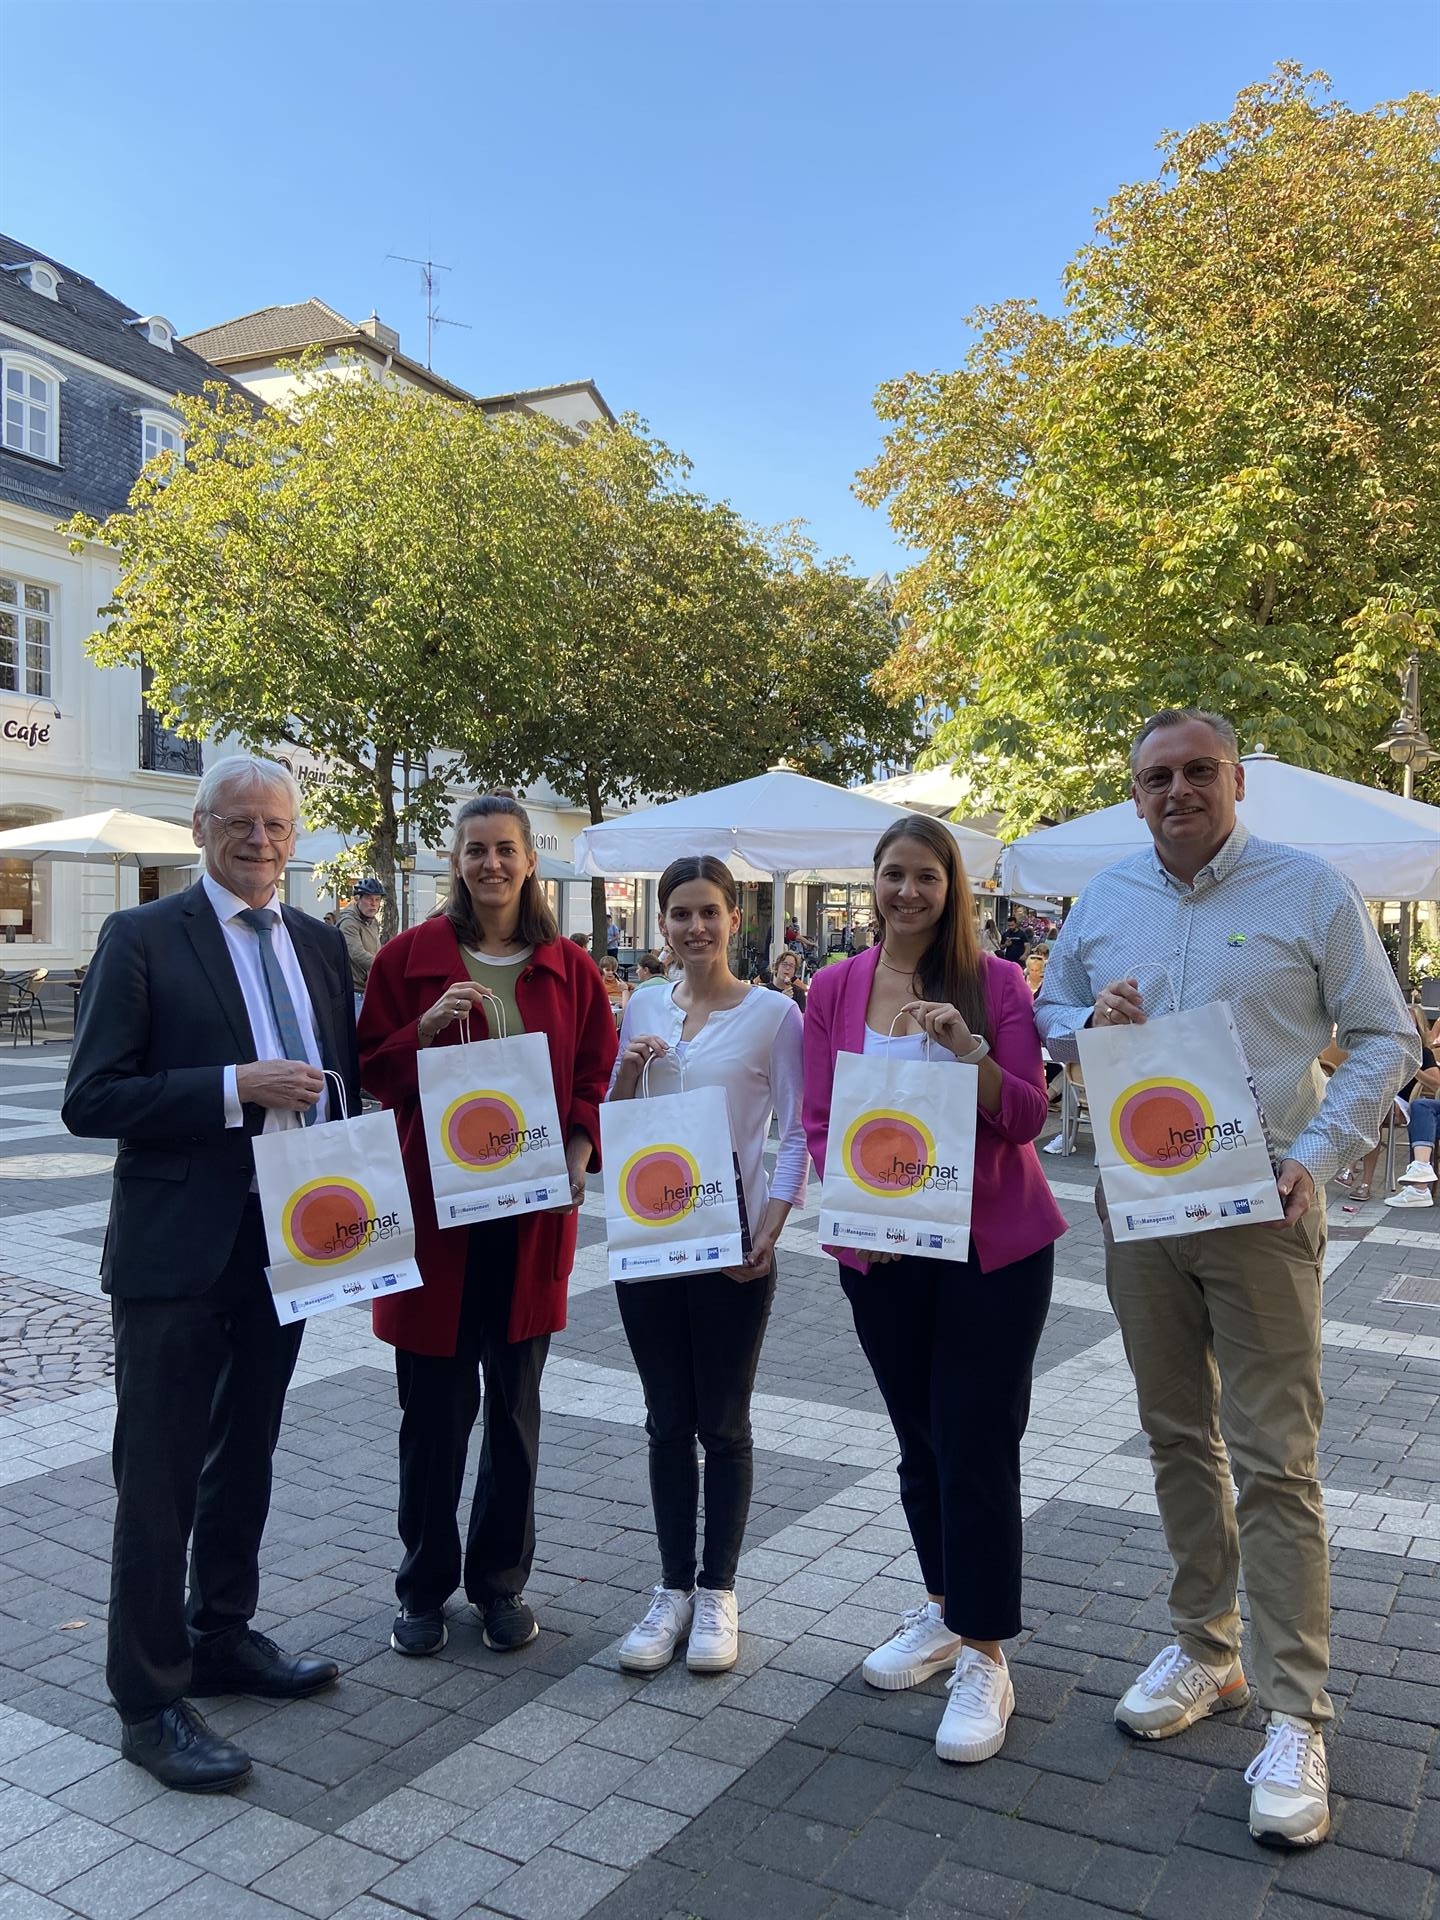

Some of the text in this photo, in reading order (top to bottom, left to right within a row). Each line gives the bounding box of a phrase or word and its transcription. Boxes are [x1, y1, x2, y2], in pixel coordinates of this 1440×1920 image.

[3, 720, 50, 747] Café
[489, 1124, 549, 1147] heimat
[1168, 1117, 1244, 1146] heimat
[478, 1137, 550, 1161] shoppen
[1156, 1134, 1248, 1162] shoppen
[878, 1168, 958, 1193] shoppen
[893, 1156, 958, 1180] heimat
[664, 1179, 723, 1201] heimat
[652, 1193, 725, 1215] shoppen
[335, 1211, 400, 1239] heimat
[324, 1225, 401, 1254] shoppen
